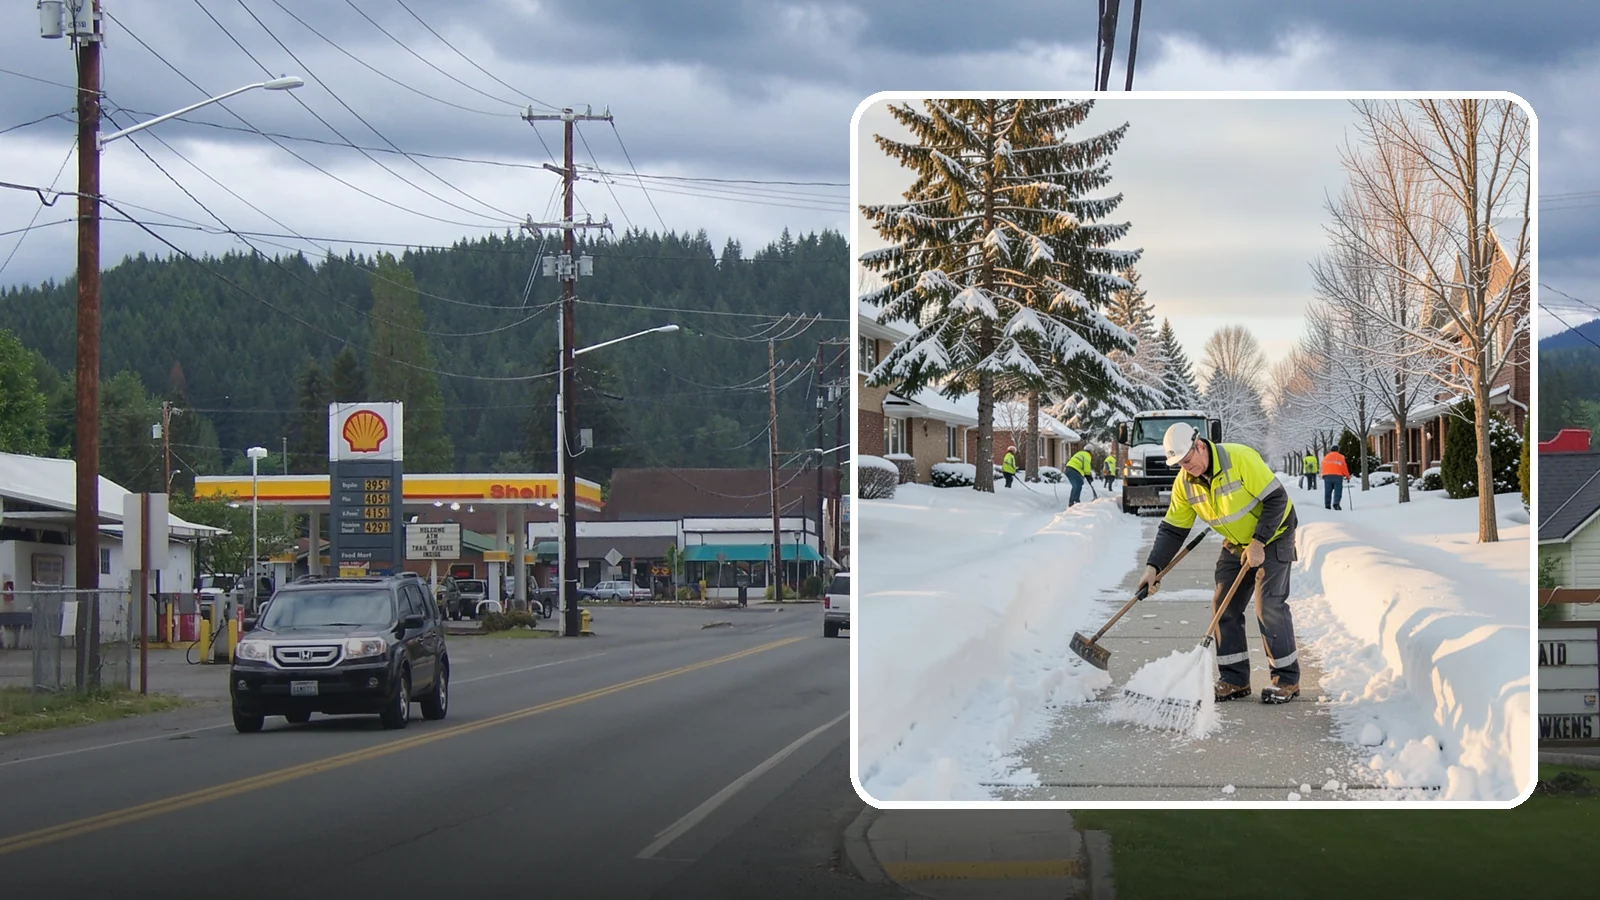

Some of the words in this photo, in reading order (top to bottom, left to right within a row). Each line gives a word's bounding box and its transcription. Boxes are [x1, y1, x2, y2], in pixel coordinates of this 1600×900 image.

[366, 480, 383, 490] 395
[490, 484, 547, 499] Shell
[366, 494, 383, 504] 405
[366, 508, 383, 518] 415
[366, 522, 383, 533] 429
[1539, 642, 1567, 666] AID
